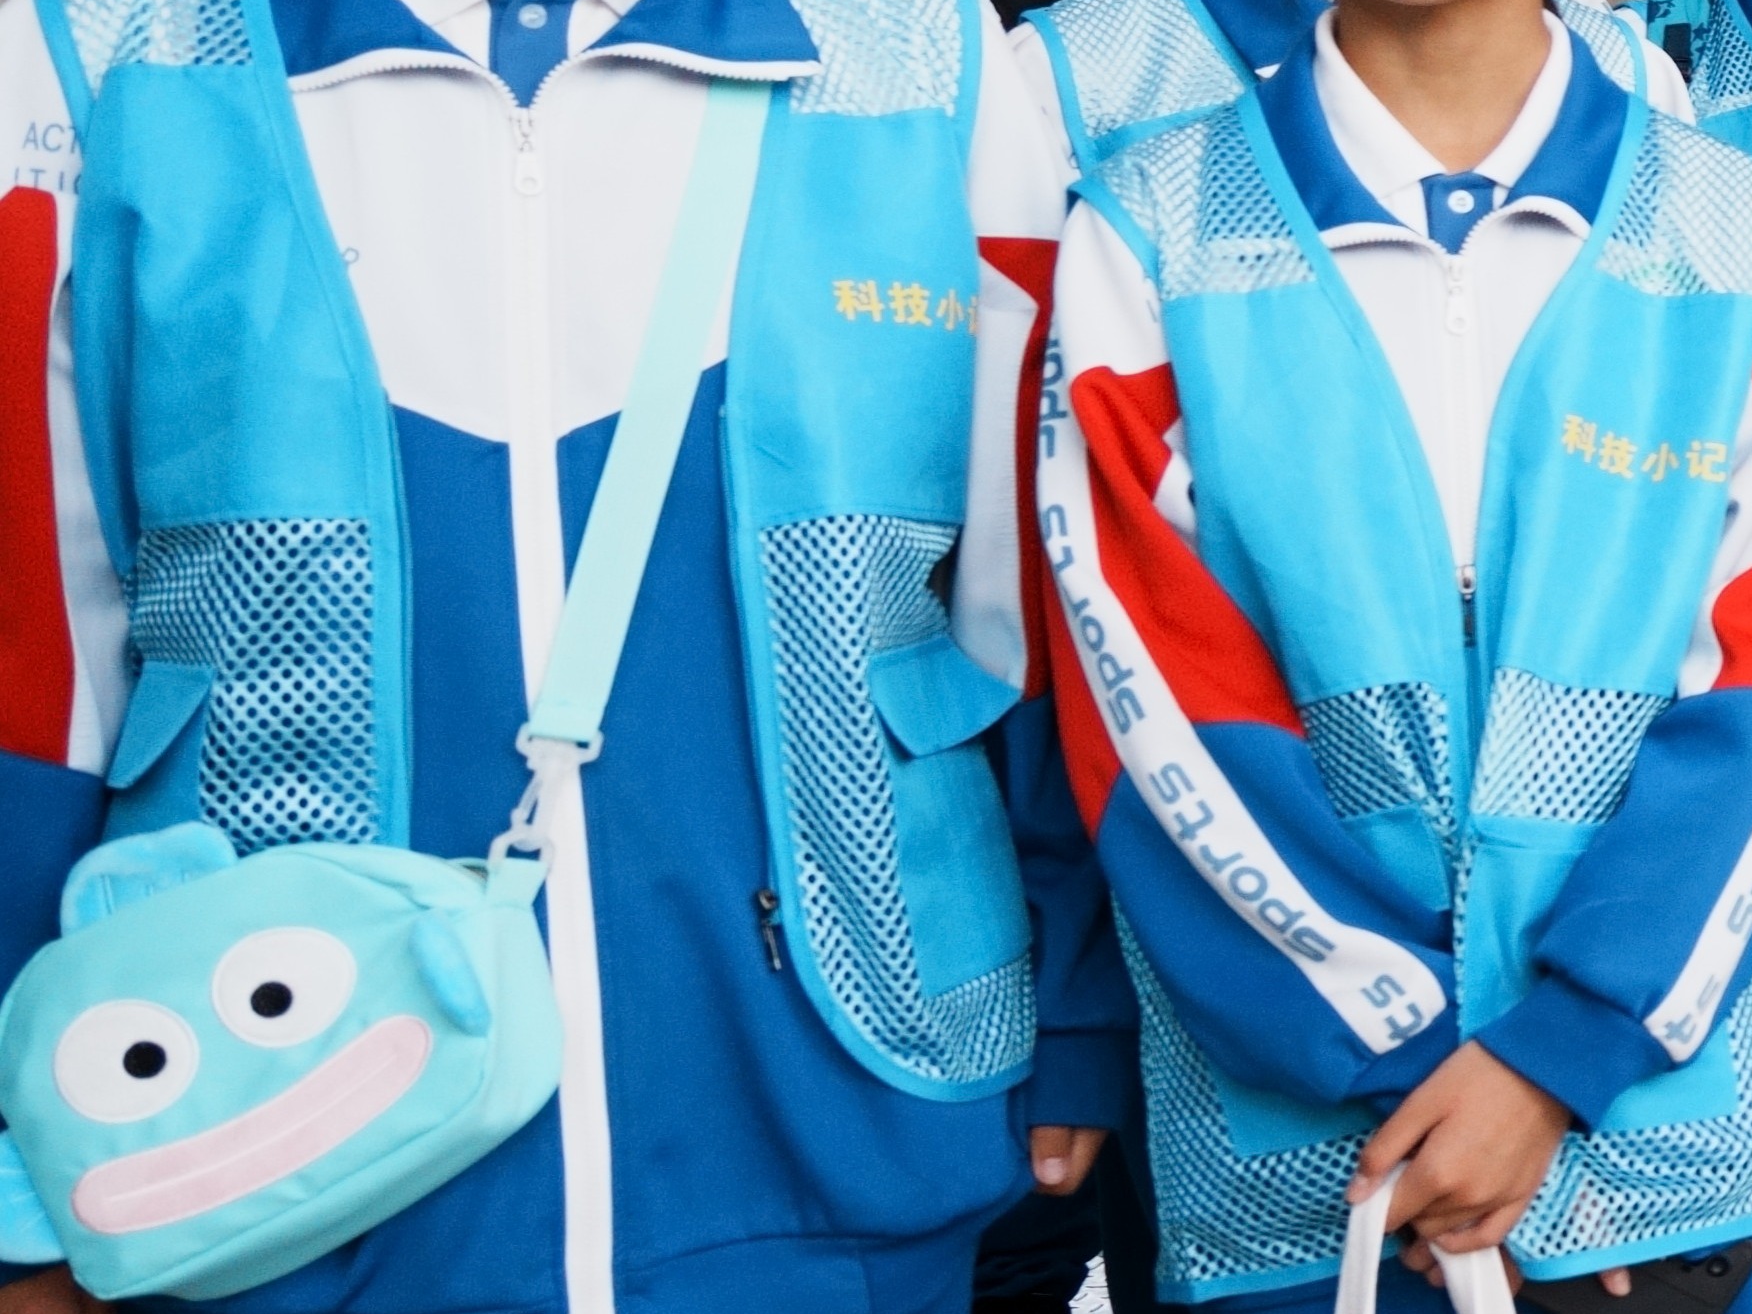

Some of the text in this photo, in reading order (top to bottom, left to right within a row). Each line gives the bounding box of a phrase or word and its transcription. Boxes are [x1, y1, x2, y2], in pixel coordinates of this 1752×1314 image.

[1561, 414, 1728, 483] 科技小记
[1040, 502, 1147, 736] Sports
[1149, 761, 1337, 964] Sports
